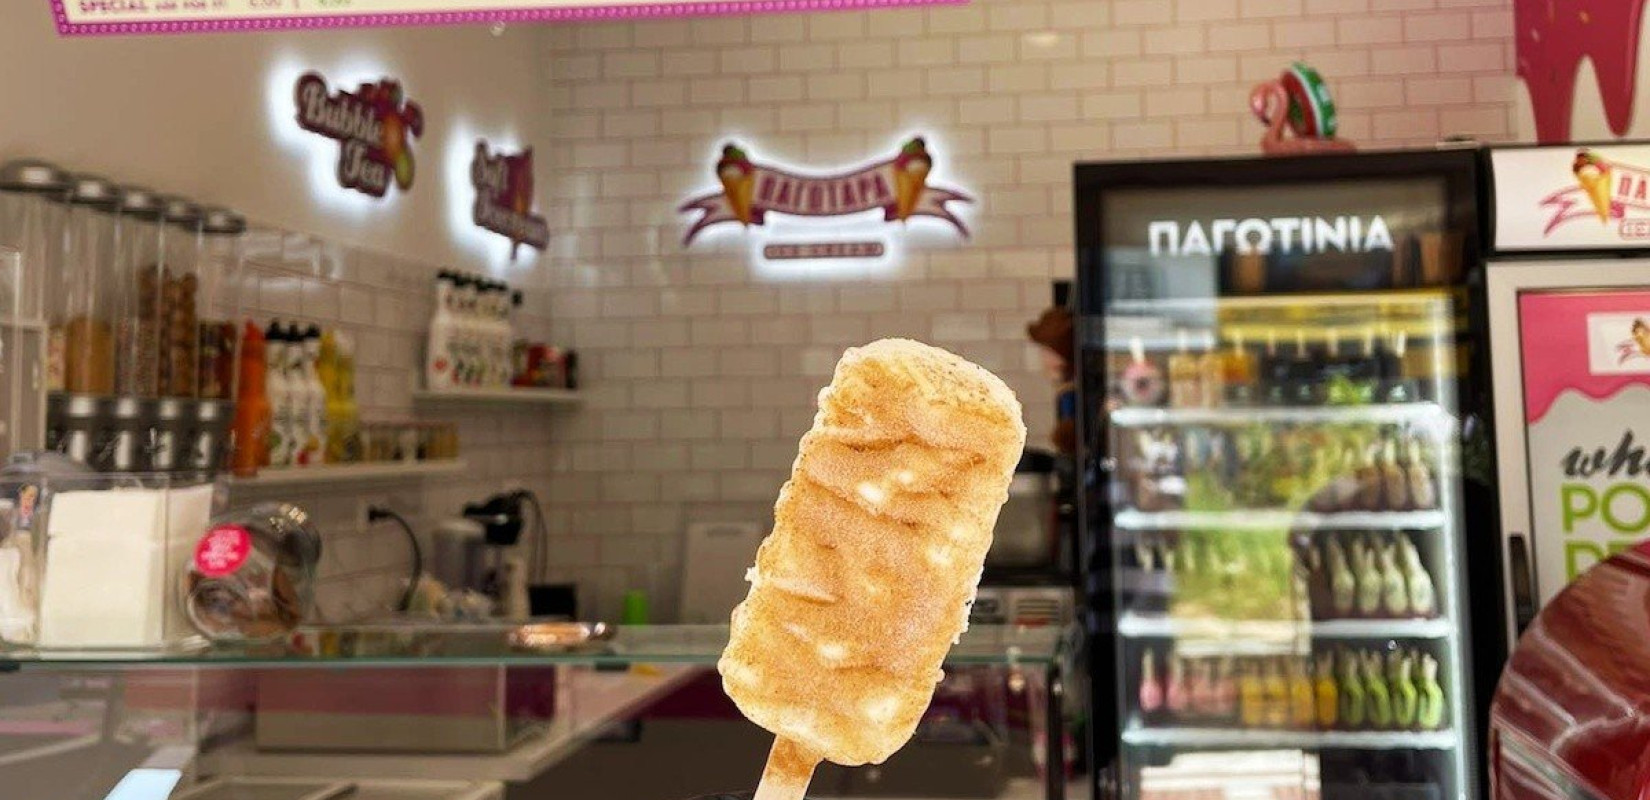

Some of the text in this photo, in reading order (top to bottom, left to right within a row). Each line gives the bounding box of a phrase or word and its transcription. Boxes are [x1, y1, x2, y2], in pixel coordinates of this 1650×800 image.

[301, 82, 384, 146] Bubble
[345, 142, 387, 193] Tea
[1562, 429, 1650, 478] wh
